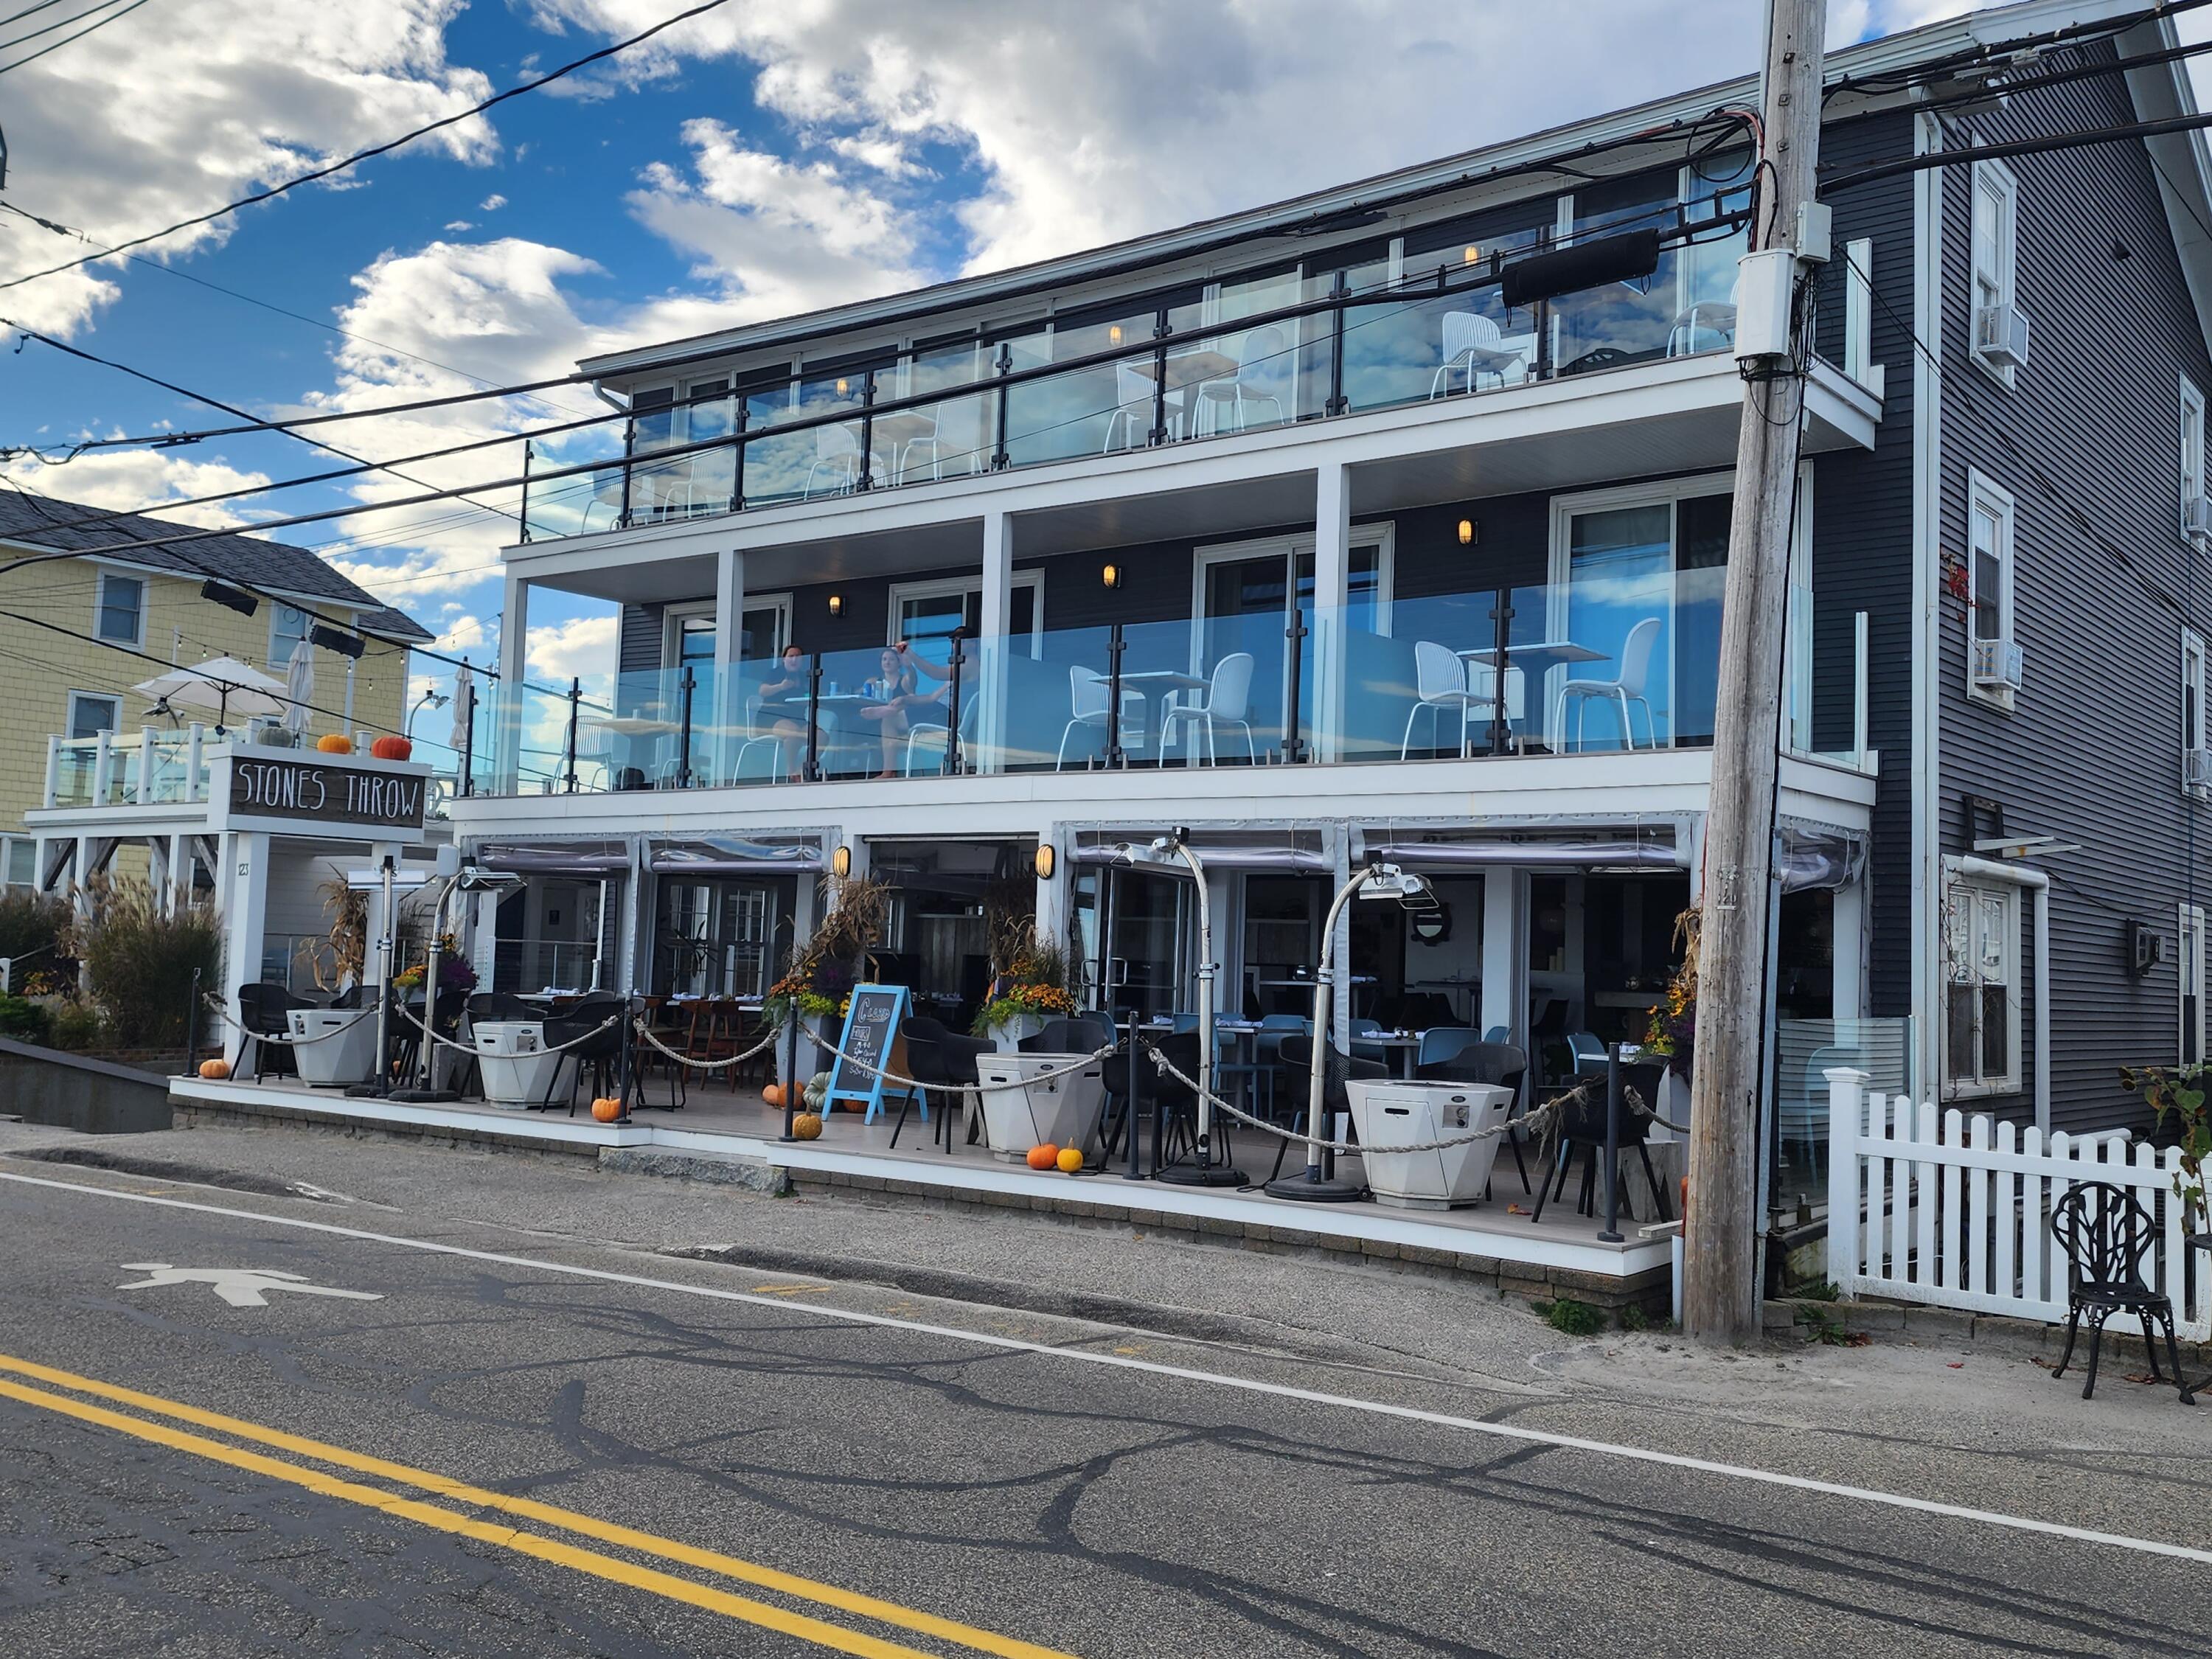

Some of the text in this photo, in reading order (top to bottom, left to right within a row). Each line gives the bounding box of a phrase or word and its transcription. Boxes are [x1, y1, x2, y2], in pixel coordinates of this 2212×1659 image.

[239, 763, 418, 818] STONES THROW
[238, 863, 249, 876] 123
